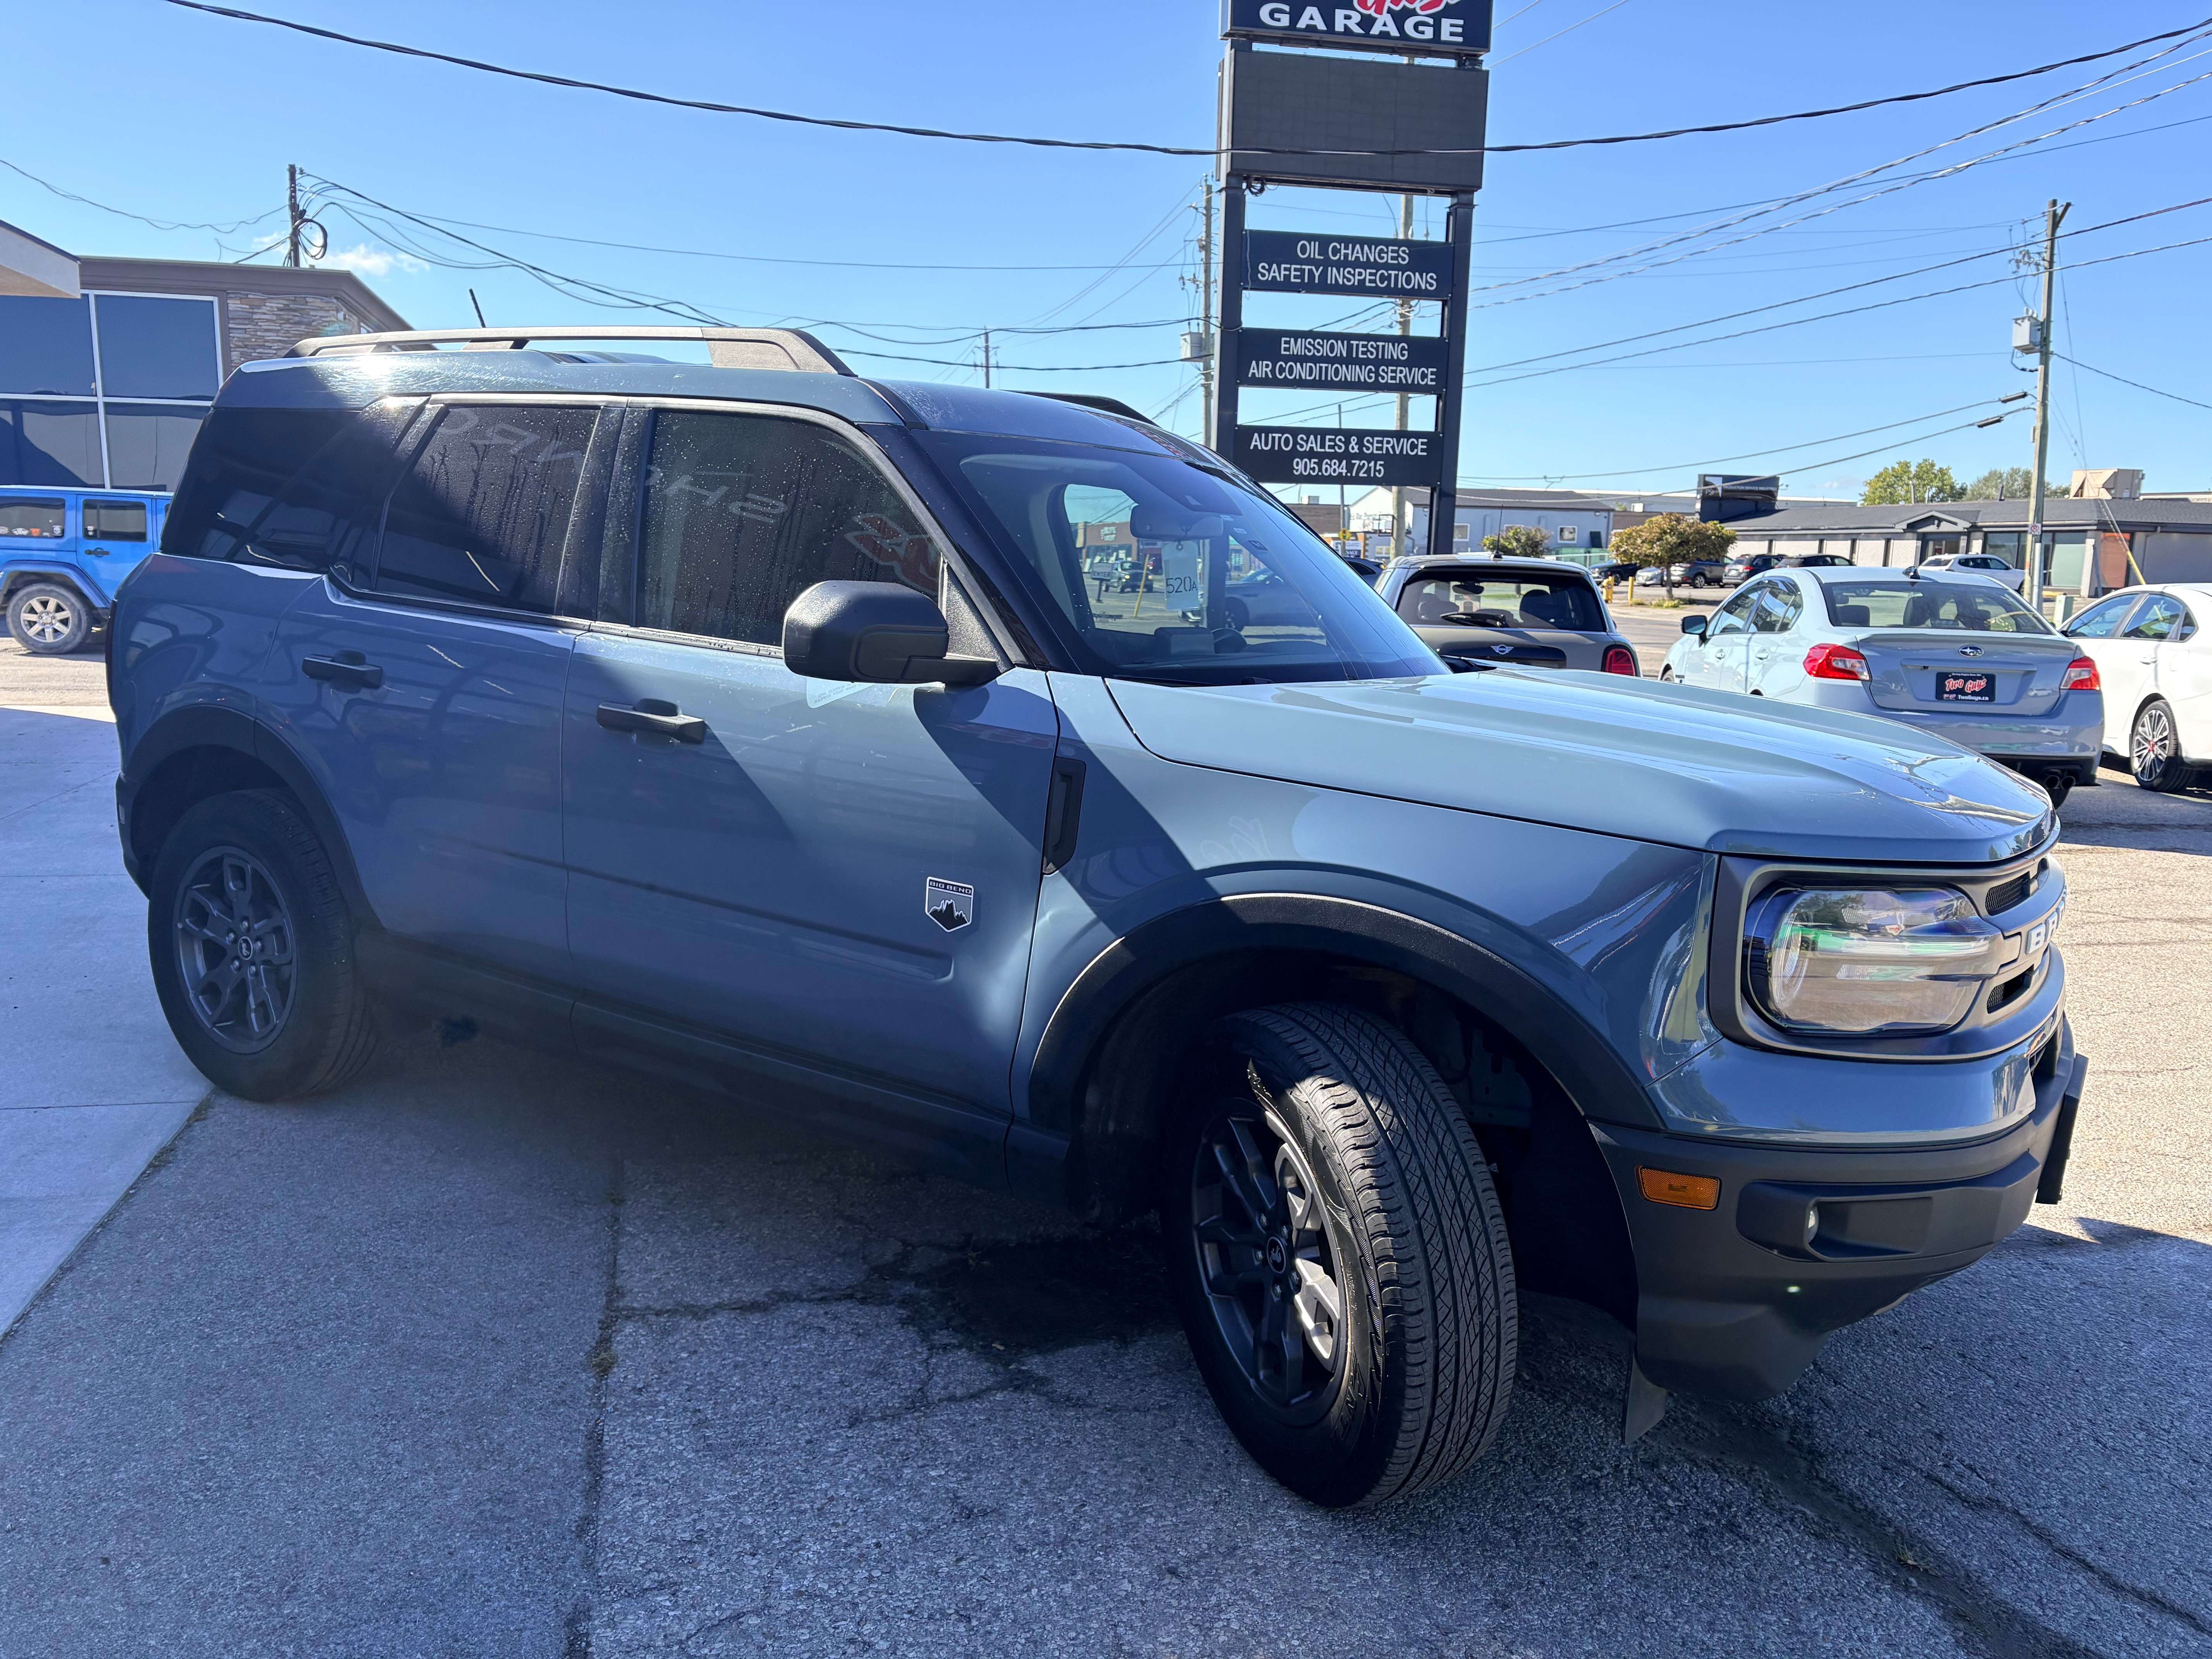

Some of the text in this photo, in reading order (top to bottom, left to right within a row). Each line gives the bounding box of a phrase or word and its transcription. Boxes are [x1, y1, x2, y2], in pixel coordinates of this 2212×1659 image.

[1259, 2, 1464, 42] GARAGE
[1297, 240, 1409, 264] OIL CHANGES
[1257, 263, 1437, 290] SAFETY INSPECTIONS
[1281, 337, 1408, 360] EMISSION TESTING
[1248, 361, 1437, 385] AIR CONDITIONING SERVICE
[1250, 433, 1428, 455] AUTO SALES & SERVICE
[1293, 458, 1384, 477] 905.684.7215
[947, 884, 971, 894] BEND
